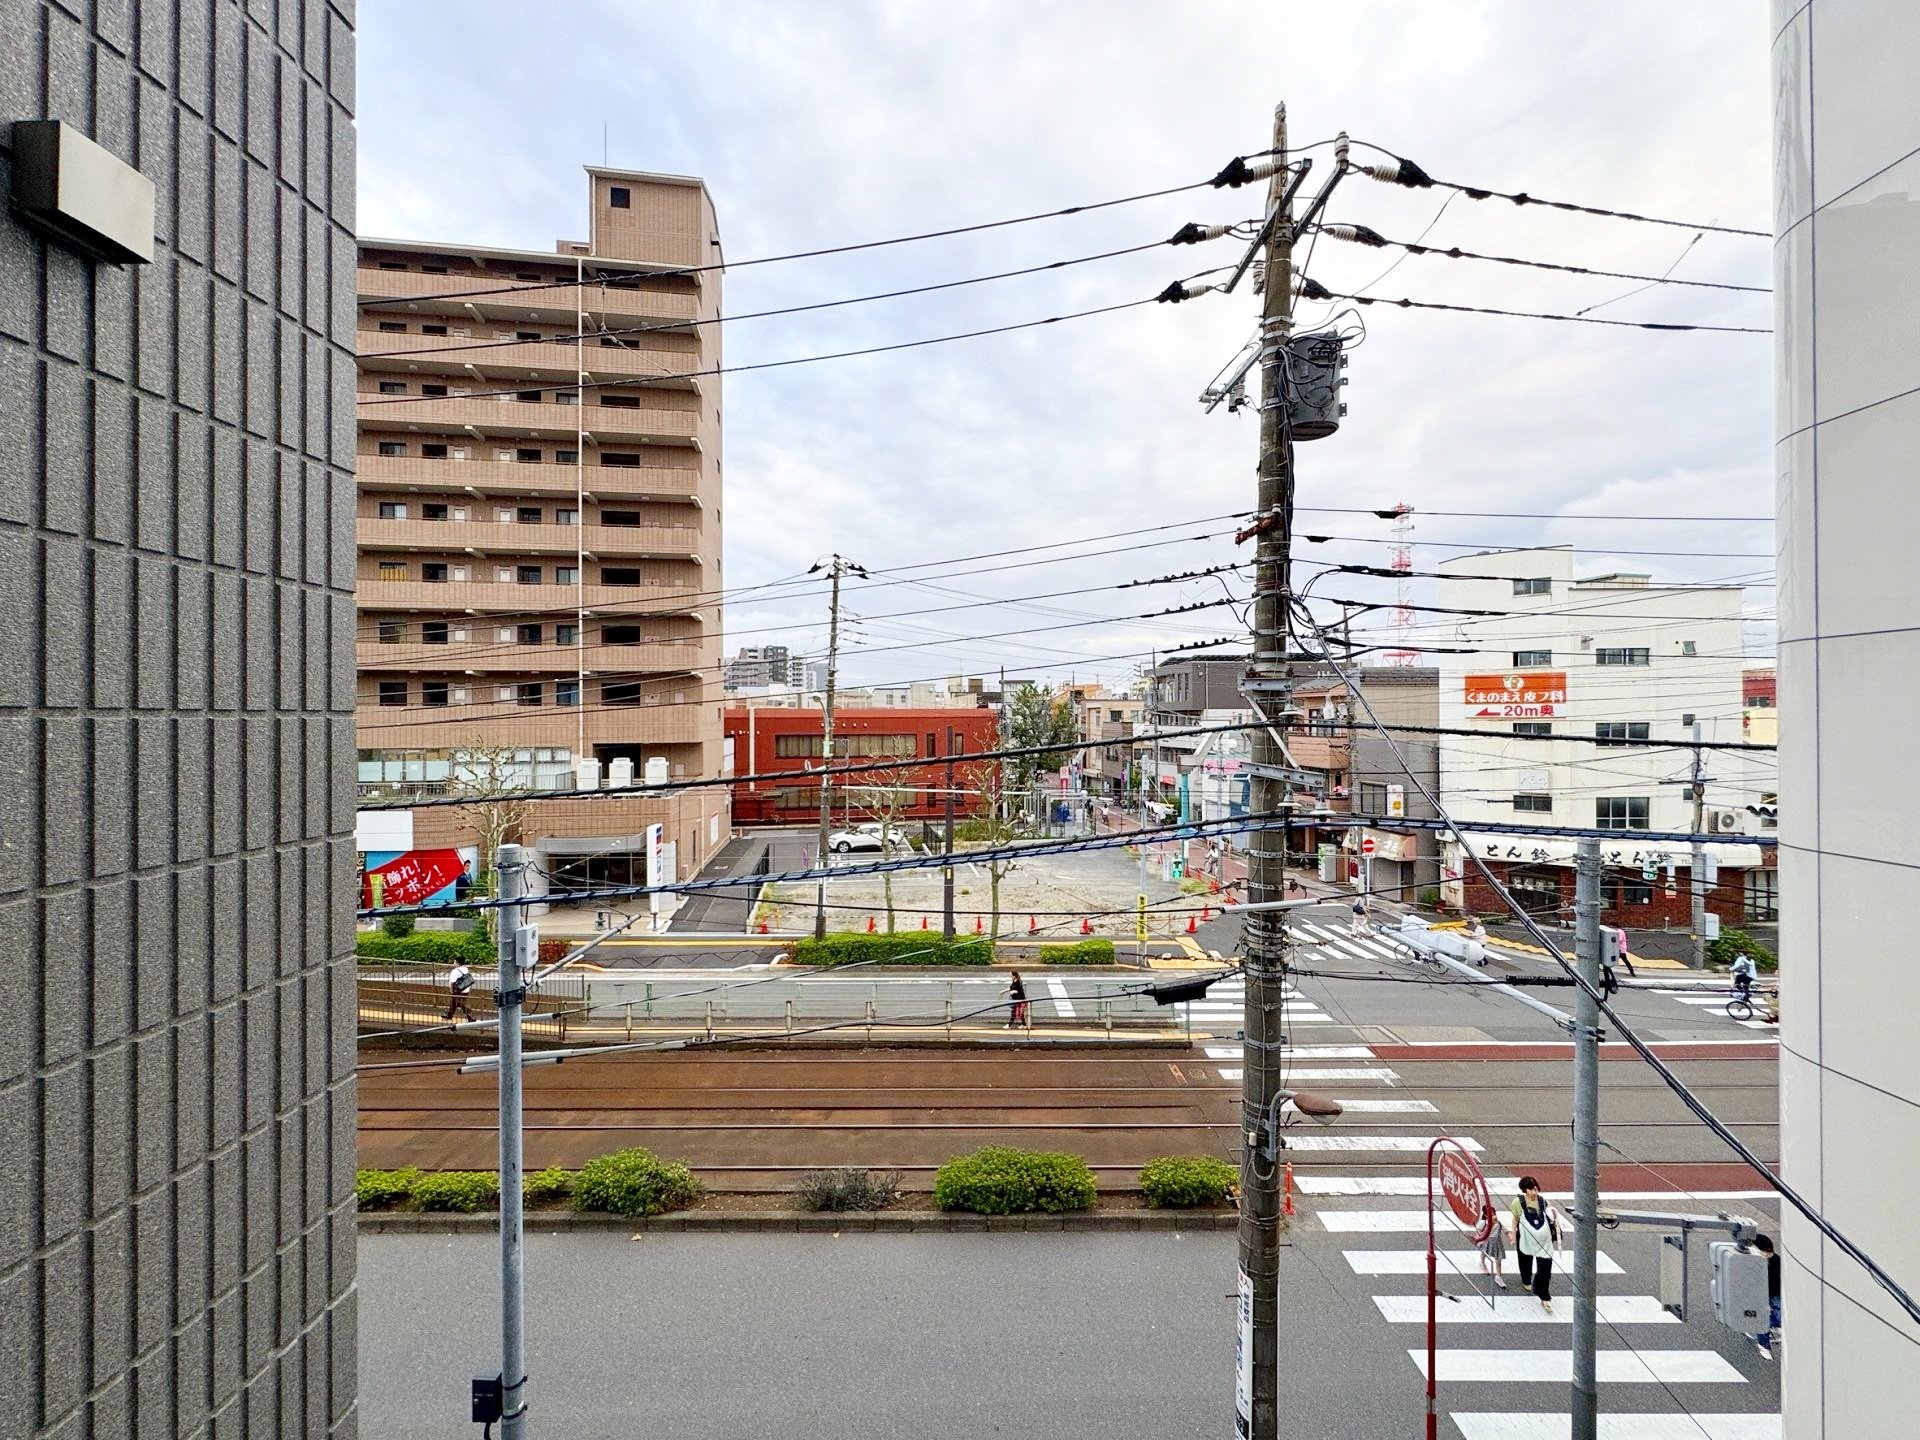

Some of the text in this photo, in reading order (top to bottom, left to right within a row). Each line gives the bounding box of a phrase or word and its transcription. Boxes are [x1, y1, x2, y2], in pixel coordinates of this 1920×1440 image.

[1503, 705, 1554, 716] 20m奥
[1486, 844, 1551, 860] とん鈴
[1442, 1162, 1478, 1217] 消火栓
